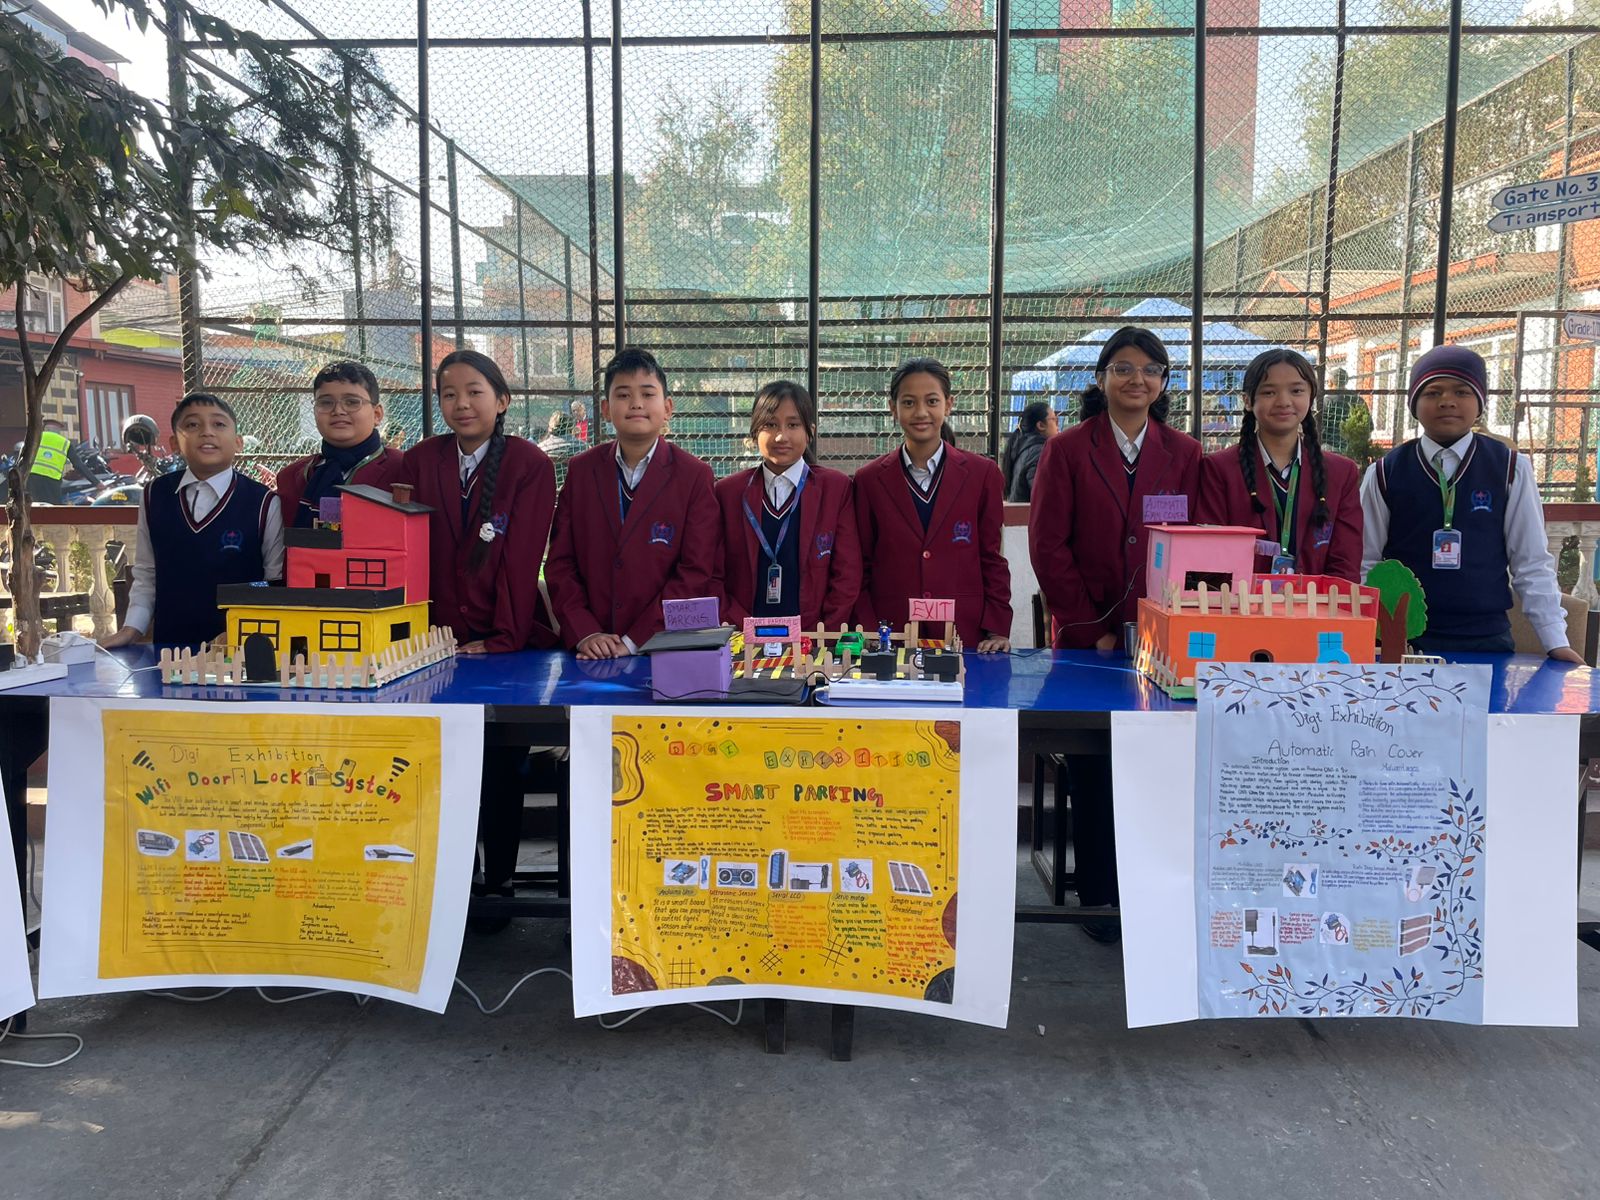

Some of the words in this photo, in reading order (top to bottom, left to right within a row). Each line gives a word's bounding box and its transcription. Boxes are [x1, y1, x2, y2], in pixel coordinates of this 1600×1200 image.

[1504, 187, 1549, 206] Gate
[1556, 181, 1582, 197] No.
[1586, 176, 1598, 191] 3
[666, 602, 698, 613] SMART
[912, 600, 952, 620] EXIT
[667, 614, 710, 626] PARKING
[1292, 710, 1322, 734] Digi
[1330, 704, 1394, 736] Exhibition
[170, 744, 199, 764] Digi
[228, 747, 323, 763] Exhibition
[671, 743, 736, 756] DIGI
[766, 749, 928, 768] EXHIBITION
[1268, 739, 1334, 758] Automatic
[1350, 740, 1376, 758] Rain
[1388, 744, 1424, 759] Cover
[1252, 756, 1290, 765] Introduction
[136, 778, 172, 805] Wifi
[188, 771, 231, 786] Door
[254, 768, 302, 786] Lock
[331, 771, 402, 804] System
[705, 783, 780, 801] SMART
[794, 784, 884, 808] PARKING
[271, 820, 284, 829] Used
